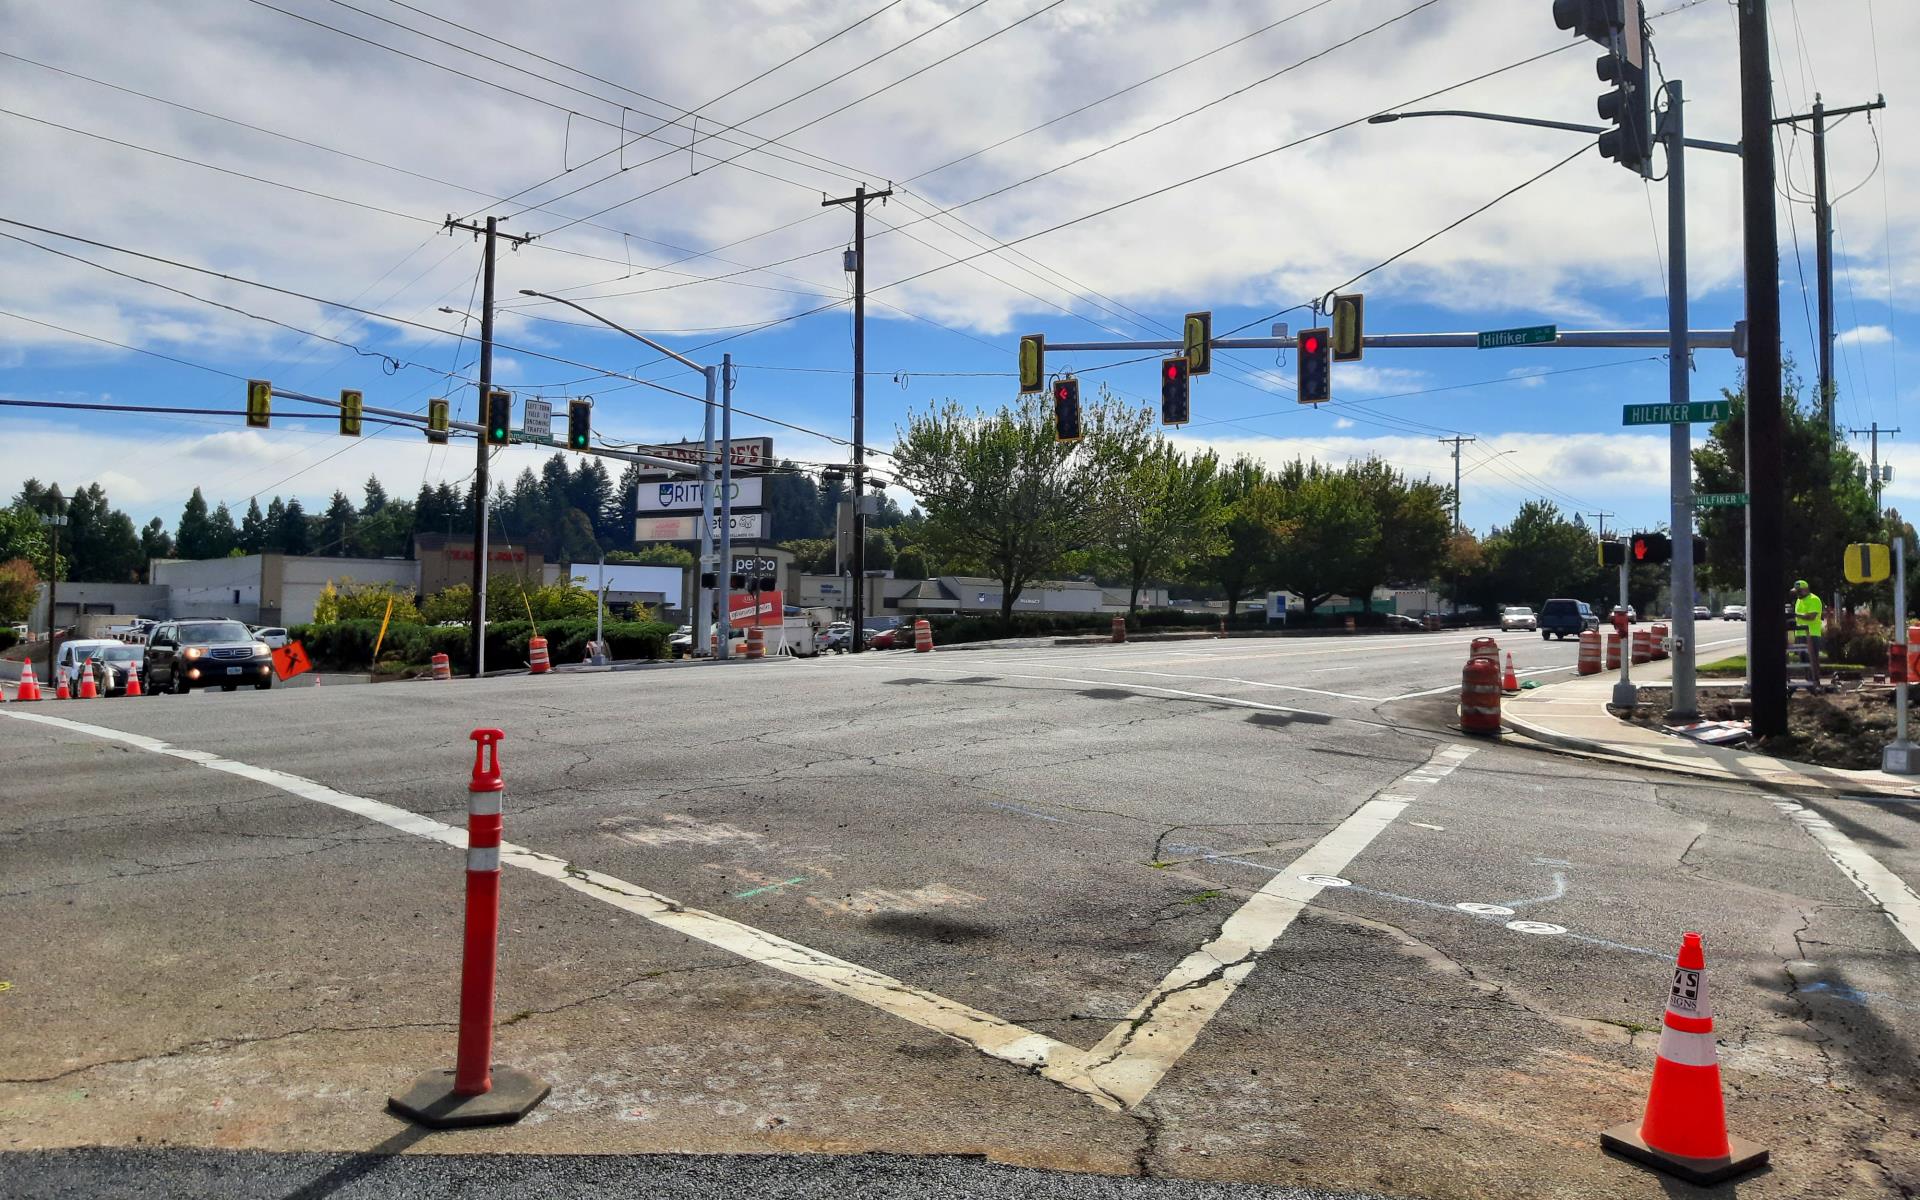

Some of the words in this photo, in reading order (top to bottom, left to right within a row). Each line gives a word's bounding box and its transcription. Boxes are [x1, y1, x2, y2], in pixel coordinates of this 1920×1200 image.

[1483, 332, 1527, 347] Hilfiker
[1632, 404, 1689, 422] HILFIKER
[1703, 404, 1719, 420] LA
[1697, 495, 1736, 504] HILFIKER
[735, 559, 776, 573] peco
[1670, 996, 1697, 1009] SIGNS
